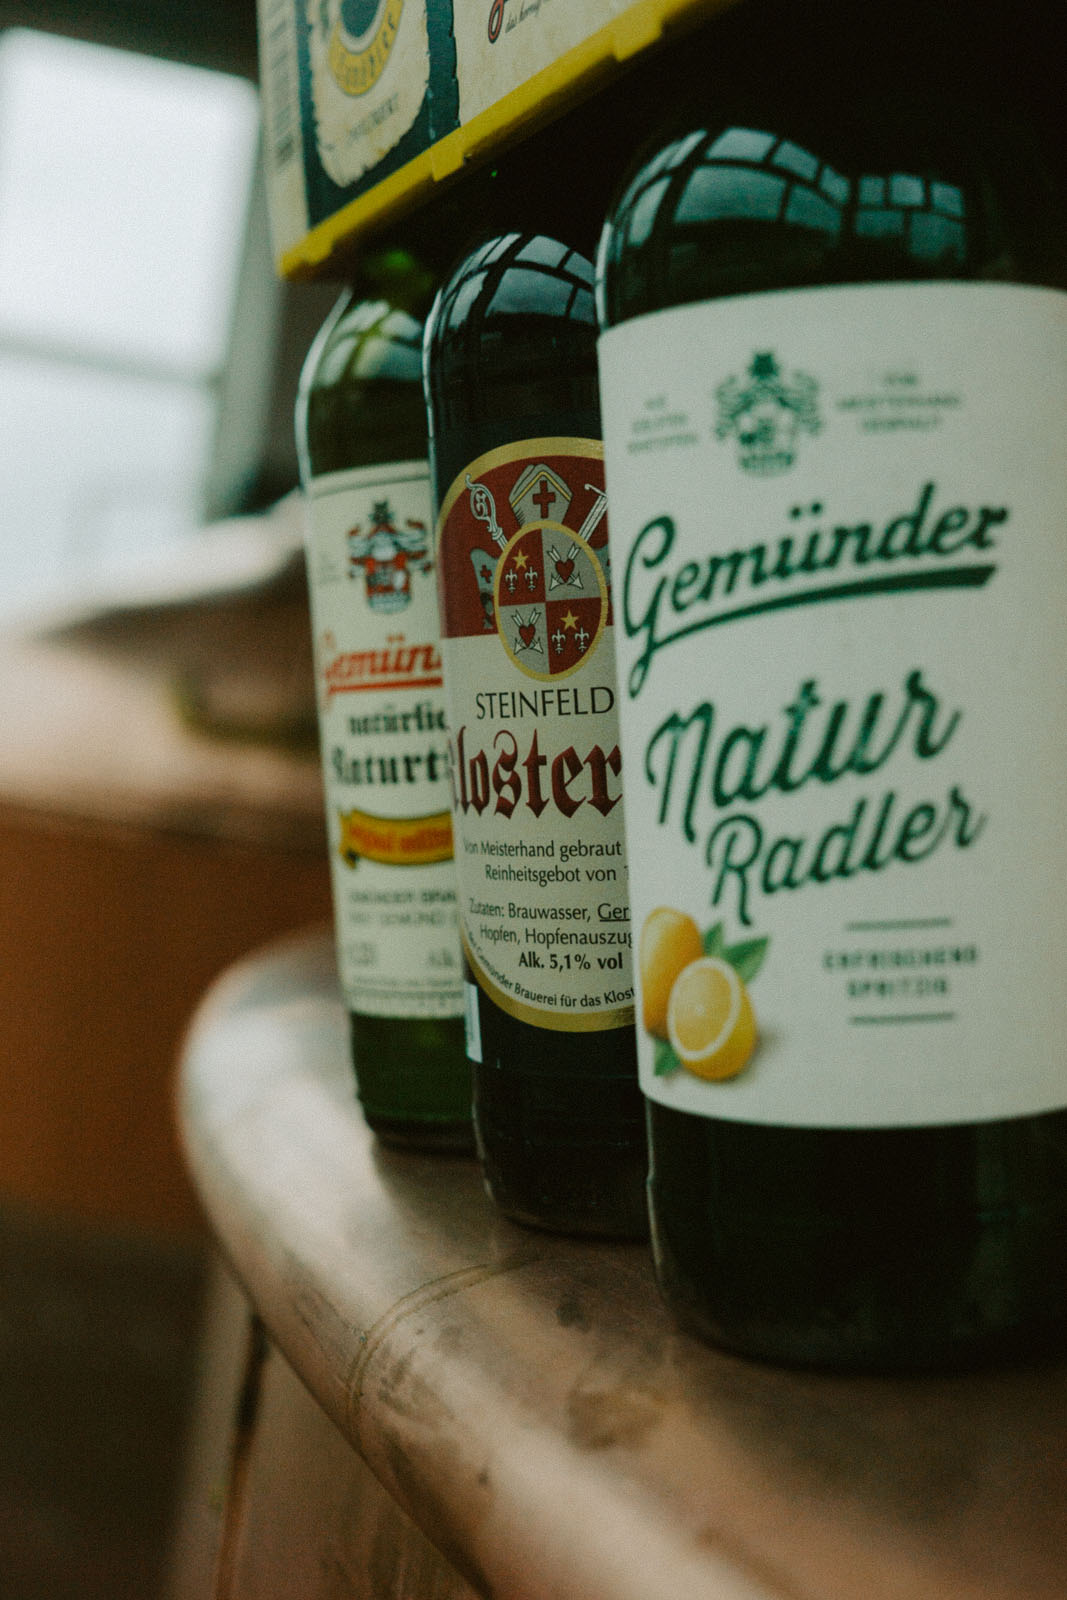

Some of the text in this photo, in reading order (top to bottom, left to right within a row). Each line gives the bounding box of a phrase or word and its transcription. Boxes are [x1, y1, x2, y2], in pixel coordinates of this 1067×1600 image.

[624, 480, 1009, 700] Gemünder
[476, 686, 616, 720] STEINFELD
[645, 668, 962, 844] Natur
[448, 725, 624, 820] loster
[481, 840, 555, 857] Meisterhand
[559, 839, 623, 863] gebraut
[706, 785, 987, 927] Radler
[485, 864, 581, 888] Reinheitsgebot
[585, 868, 617, 882] von
[508, 902, 591, 922] Brauwasser,
[479, 923, 521, 945] Hopfen,
[518, 951, 545, 969] Alk.
[597, 951, 624, 970] vol
[514, 982, 558, 1006] Brauerei
[560, 993, 578, 1008] für
[580, 994, 602, 1008] das
